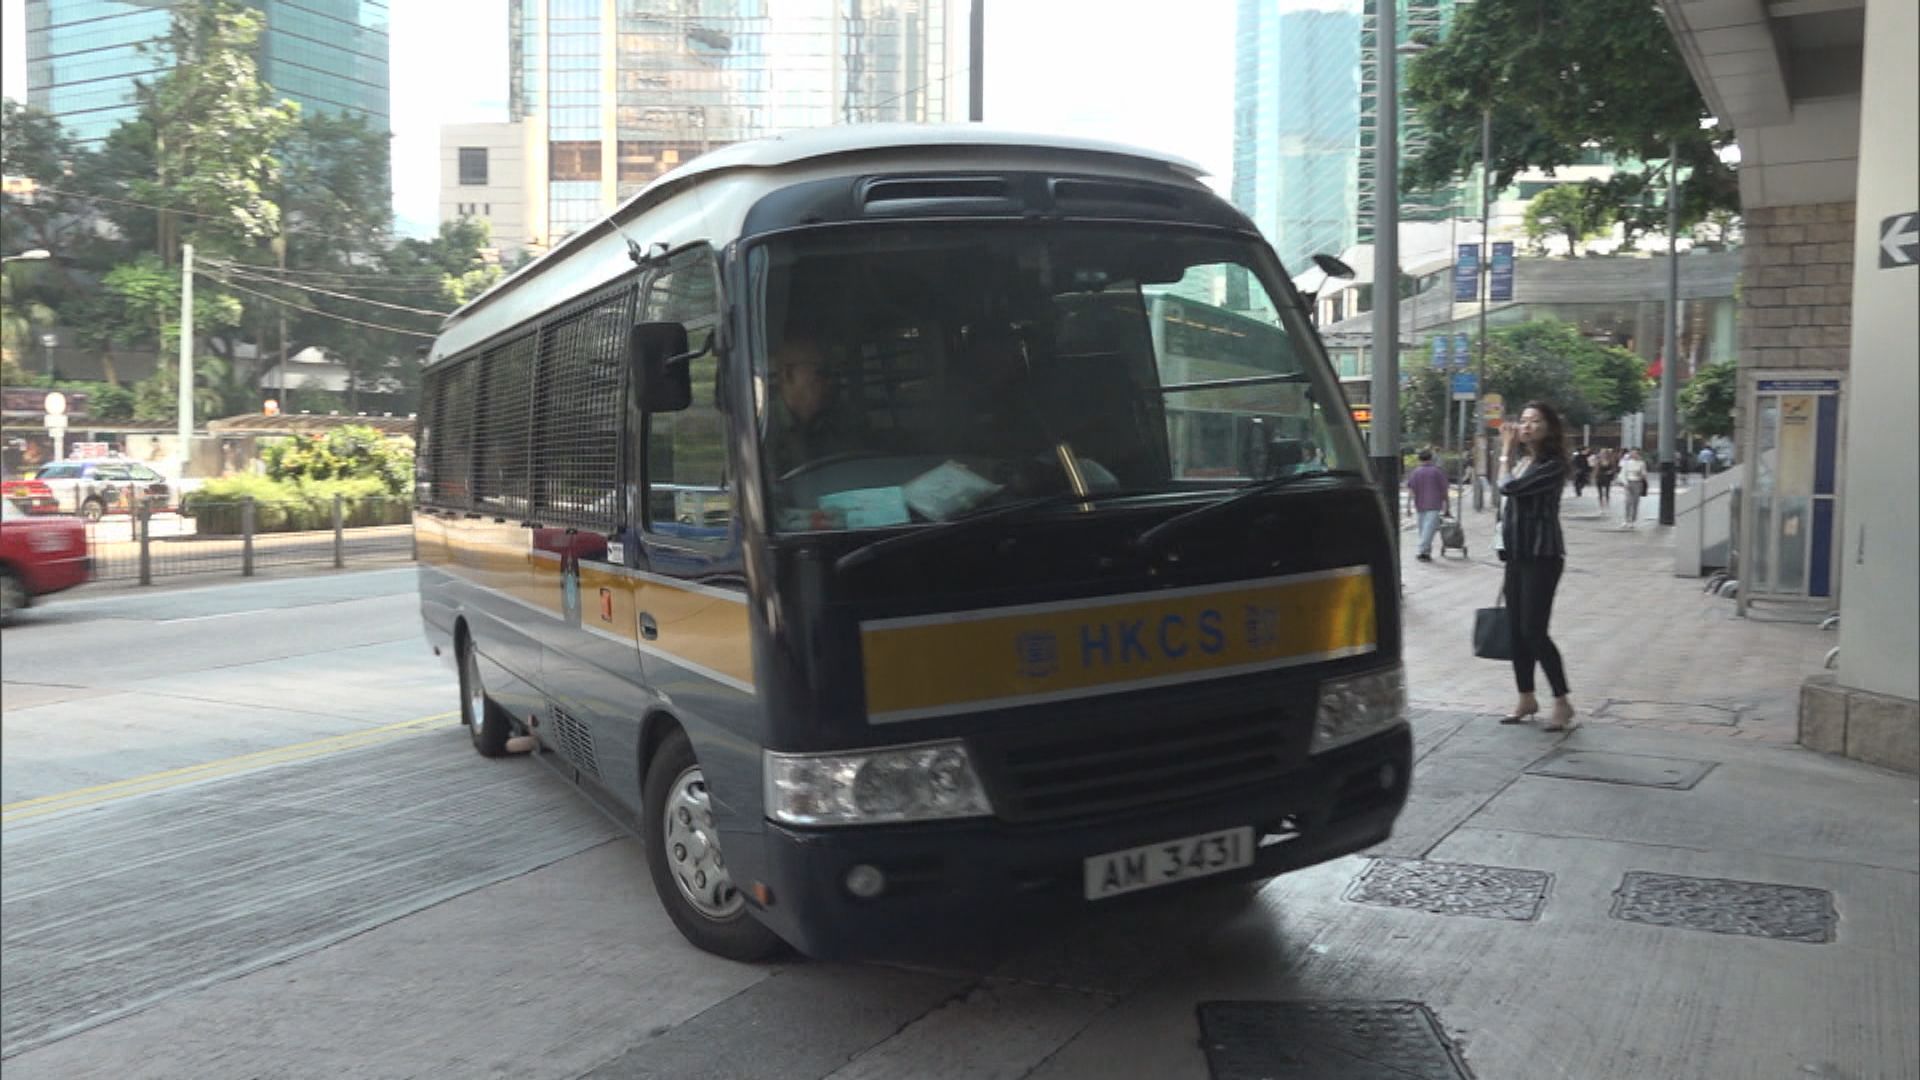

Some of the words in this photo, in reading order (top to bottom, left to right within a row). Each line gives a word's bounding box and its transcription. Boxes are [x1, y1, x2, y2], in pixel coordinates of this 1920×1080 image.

[1081, 609, 1226, 667] HKCS
[1103, 854, 1147, 890] AM
[1162, 834, 1240, 877] 3431
